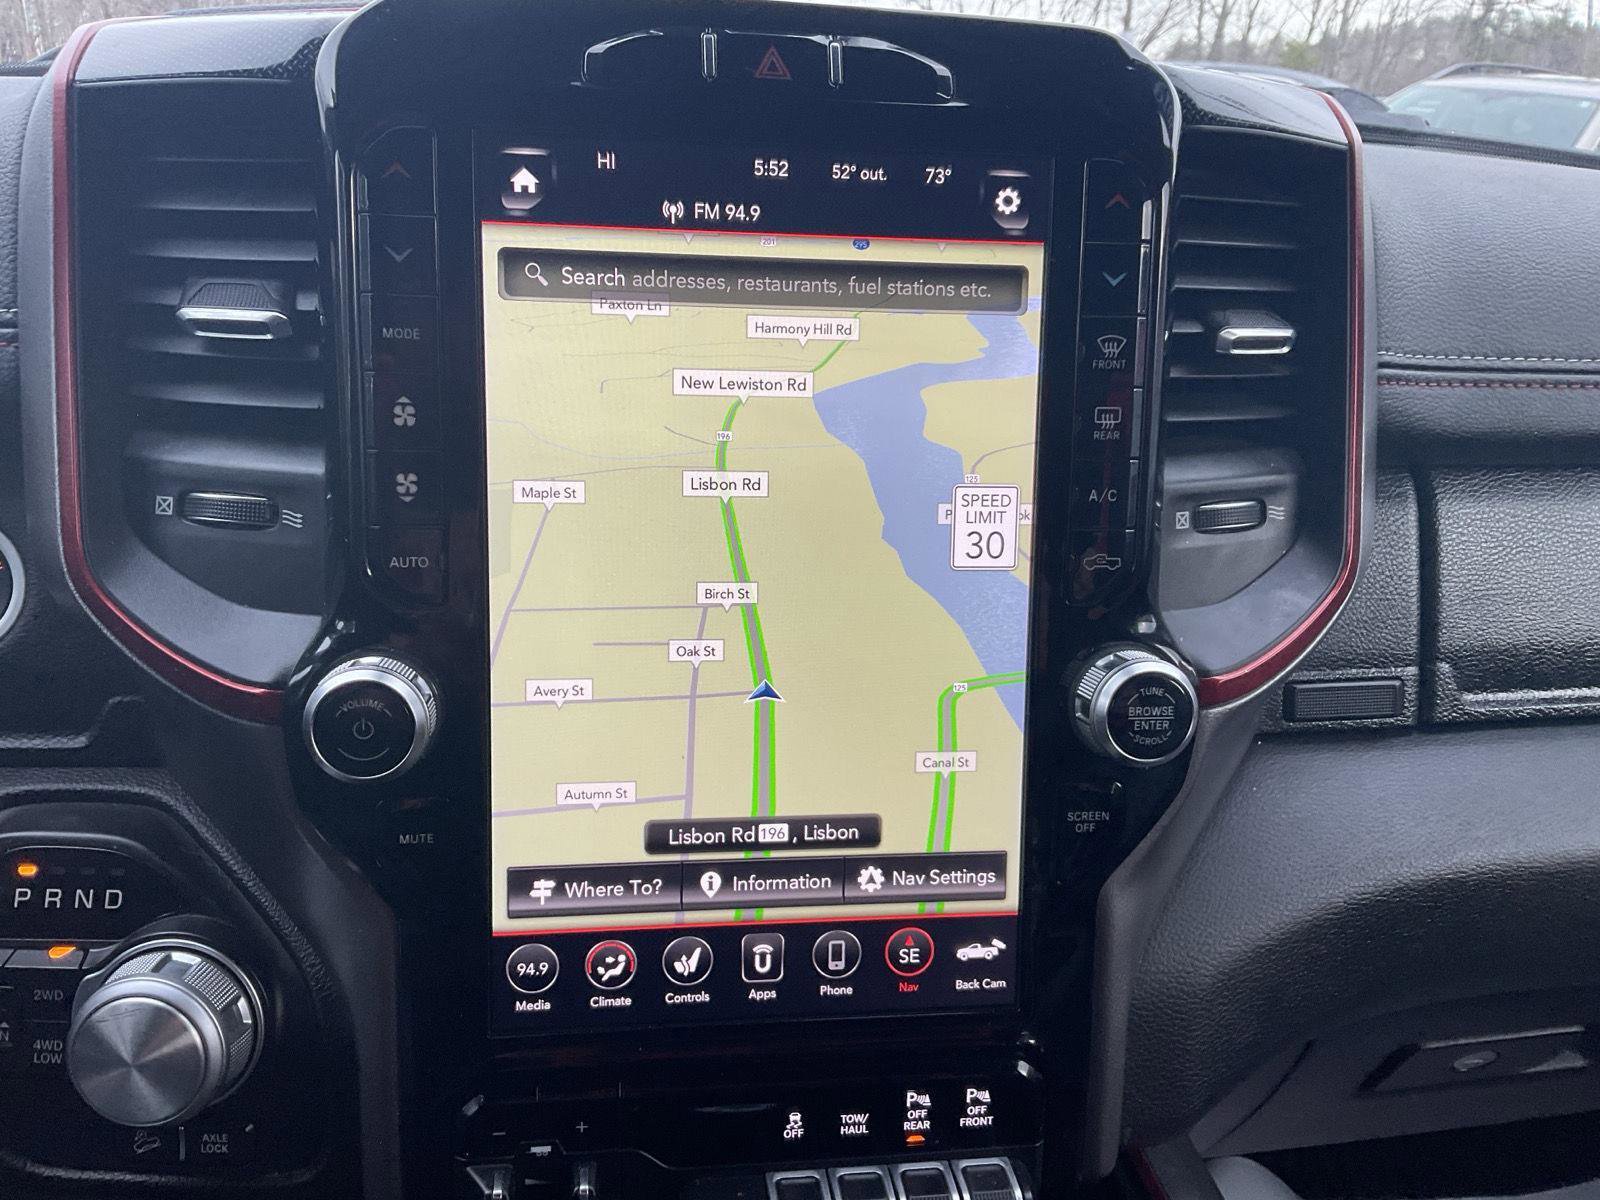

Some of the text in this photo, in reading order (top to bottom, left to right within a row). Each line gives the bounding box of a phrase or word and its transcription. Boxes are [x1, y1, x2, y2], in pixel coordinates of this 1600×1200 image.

[596, 151, 616, 170] HI
[753, 158, 790, 177] 5:52
[831, 163, 888, 181] 52° out.
[925, 167, 952, 185] 73°
[694, 202, 761, 221] FM 94.9
[561, 266, 992, 298] Search addresses, restaurants, fuel stations etc.
[600, 297, 662, 311] Paxton Ln
[382, 327, 421, 340] MODE
[755, 322, 852, 337] Harmony Hill Rd
[1091, 359, 1127, 370] FRONT
[681, 376, 807, 391] New Lewiston Rd
[717, 432, 731, 441] 196
[1093, 430, 1121, 441] REAR
[690, 477, 761, 491] Lisbon Rd
[966, 475, 979, 483] 125
[521, 486, 577, 501] Maple St
[1088, 488, 1118, 504] A/C
[961, 494, 1012, 508] SPEED
[966, 511, 1007, 524] LIMIT
[965, 531, 1005, 559] 30
[389, 556, 429, 569] AUTO
[704, 588, 750, 600] Birch St
[676, 645, 716, 657] Oak St
[533, 685, 585, 699] Avery St
[1139, 686, 1165, 697] TUNE
[340, 699, 385, 713] VOLUME
[1128, 705, 1175, 717] BROWSE
[1134, 720, 1170, 731] ENTER
[1133, 734, 1169, 746] SCROLL
[922, 756, 970, 769] Canal St
[564, 787, 628, 801] Autumn St
[1067, 811, 1110, 822] SCREEN
[668, 827, 726, 845] Lisbon
[731, 826, 756, 843] Rd
[760, 826, 786, 841] 196
[803, 824, 860, 841] Lisbon
[1075, 823, 1096, 833] OFF
[399, 833, 435, 845] MUTE
[733, 873, 832, 892] Information
[892, 869, 997, 887] Nav Settings
[564, 878, 663, 898] Where To?
[13, 887, 123, 910] P R N D
[899, 948, 920, 964] SE
[516, 962, 549, 977] 94.9
[899, 982, 919, 993] Nav
[955, 978, 1007, 990] Back Cam
[32, 989, 64, 1001] 2WD
[665, 991, 710, 1003] Controls
[748, 988, 777, 1001] Apps
[820, 985, 853, 997] Phone
[515, 1000, 551, 1012] Media
[590, 996, 632, 1008] Climate
[32, 1039, 63, 1052] 4WD
[32, 1052, 63, 1065] LOW
[906, 1109, 928, 1119] OFF
[966, 1105, 989, 1115] OFF
[840, 1112, 870, 1124] TOW/
[959, 1115, 995, 1127] FRONT
[840, 1124, 869, 1135] HAUL
[903, 1120, 931, 1131] REAR
[202, 1133, 229, 1143] AXLE
[783, 1128, 805, 1139] OFF
[200, 1143, 229, 1154] LOCK
